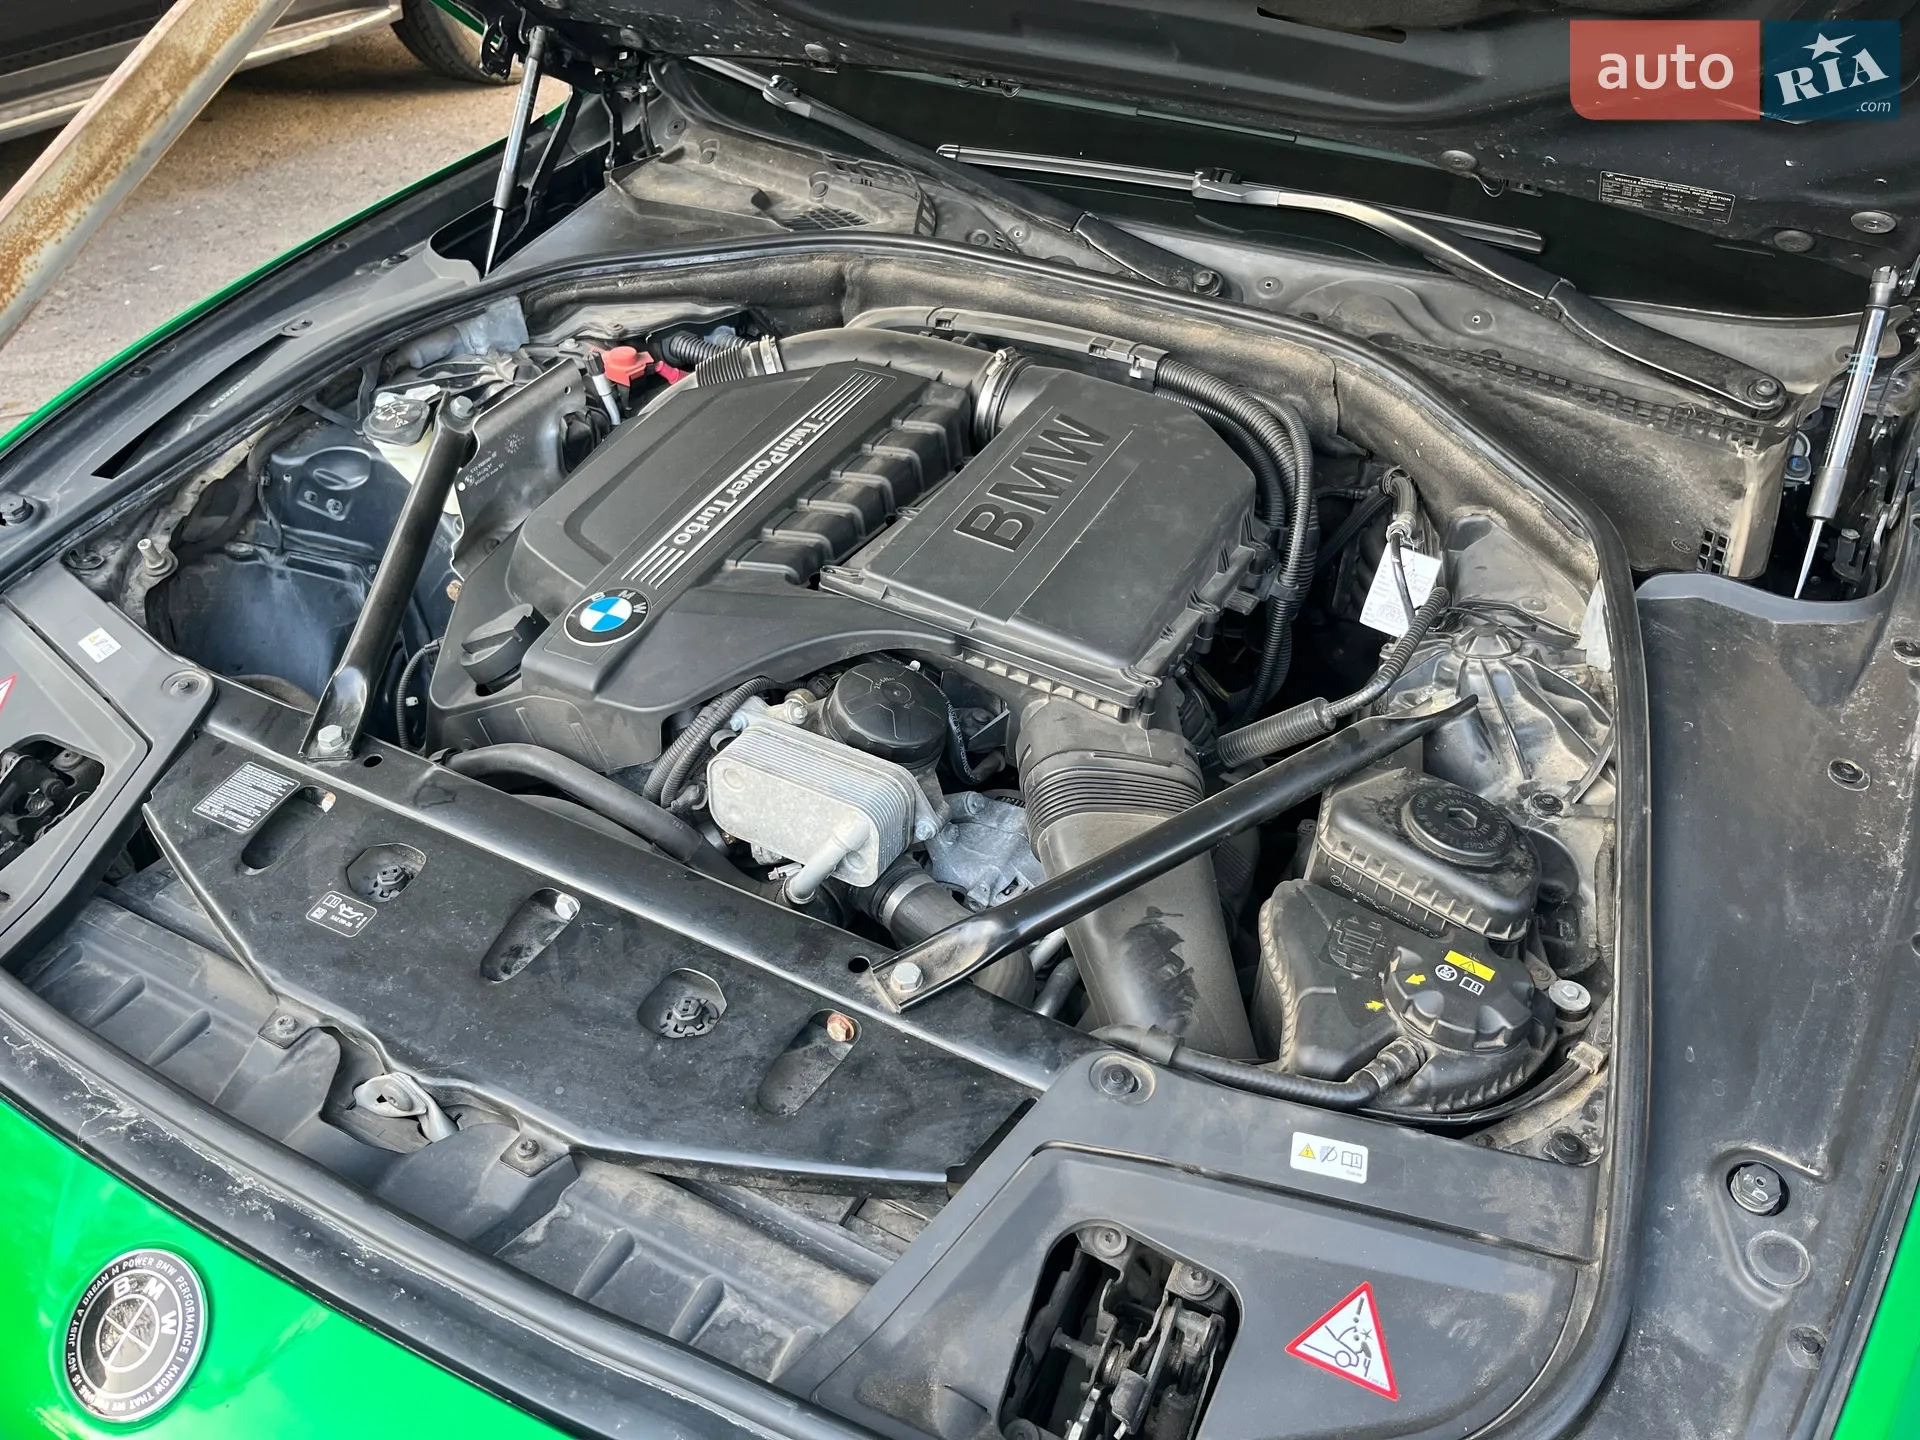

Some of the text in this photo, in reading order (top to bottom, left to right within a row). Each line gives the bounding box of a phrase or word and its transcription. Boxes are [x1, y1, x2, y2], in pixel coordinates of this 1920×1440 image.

[953, 413, 1111, 552] BMW
[589, 590, 647, 614] BMW
[111, 1265, 120, 1275] M
[122, 1257, 155, 1270] POWER
[156, 1259, 178, 1276] BMW
[82, 1273, 109, 1306] DREAM
[77, 1308, 85, 1317] A
[113, 1276, 177, 1336] BMW
[175, 1276, 196, 1354] PERFORMANCE
[68, 1319, 80, 1347] JUST
[67, 1352, 80, 1375] NOT
[155, 1365, 181, 1394] KNOW
[129, 1391, 155, 1410] THAT
